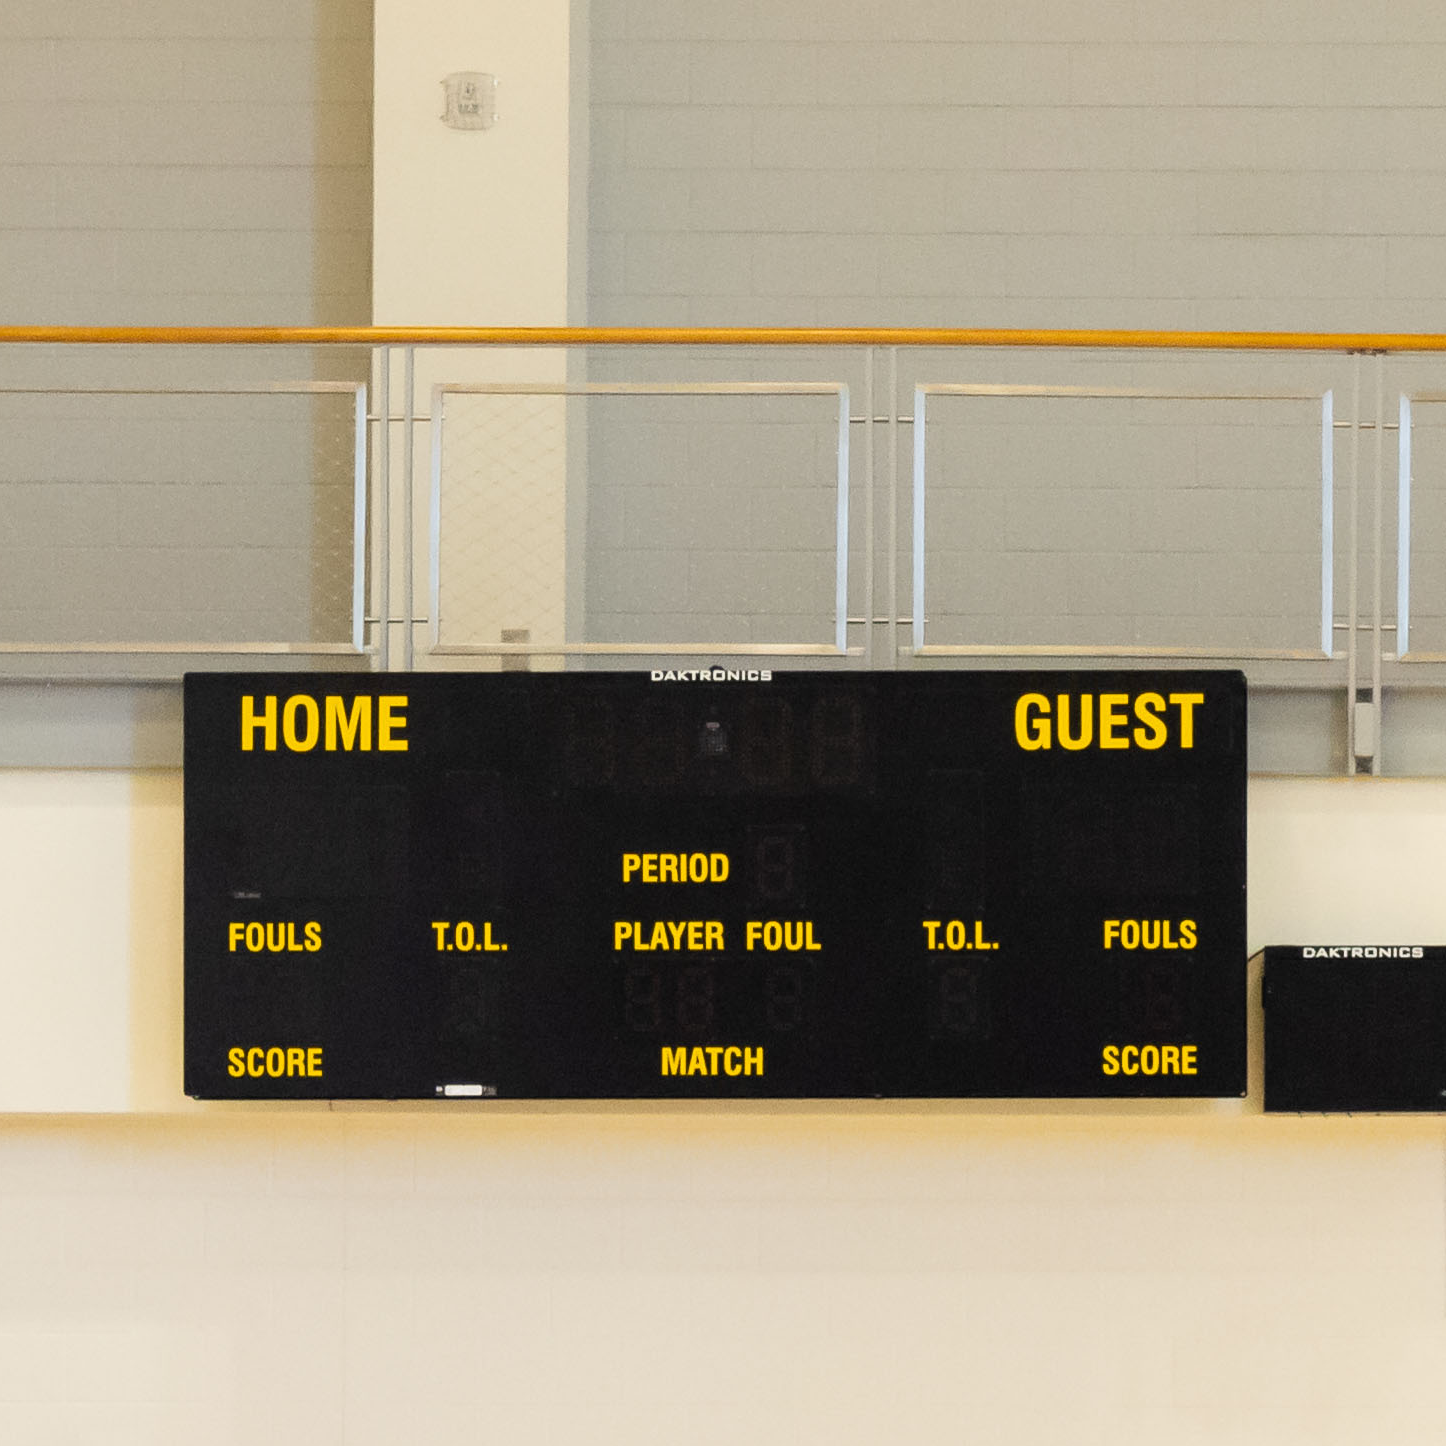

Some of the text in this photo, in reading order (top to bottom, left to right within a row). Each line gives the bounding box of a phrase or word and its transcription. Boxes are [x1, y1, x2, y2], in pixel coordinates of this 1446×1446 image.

[650, 669, 773, 682] DAKTRONICS
[241, 694, 409, 752] HOME
[1014, 692, 1205, 751] GUEST
[622, 852, 730, 883] PERIOD
[228, 921, 322, 952] FOULS
[431, 921, 508, 952] T.O.L.
[614, 920, 822, 952] PLAYER FOUL
[922, 919, 1000, 951] T.O.L.
[1103, 919, 1198, 950] FOULS
[1302, 946, 1424, 959] DAKTRONICS
[227, 1047, 323, 1078] SCORE
[661, 1046, 764, 1077] MATCH
[1102, 1044, 1198, 1076] SCORE
